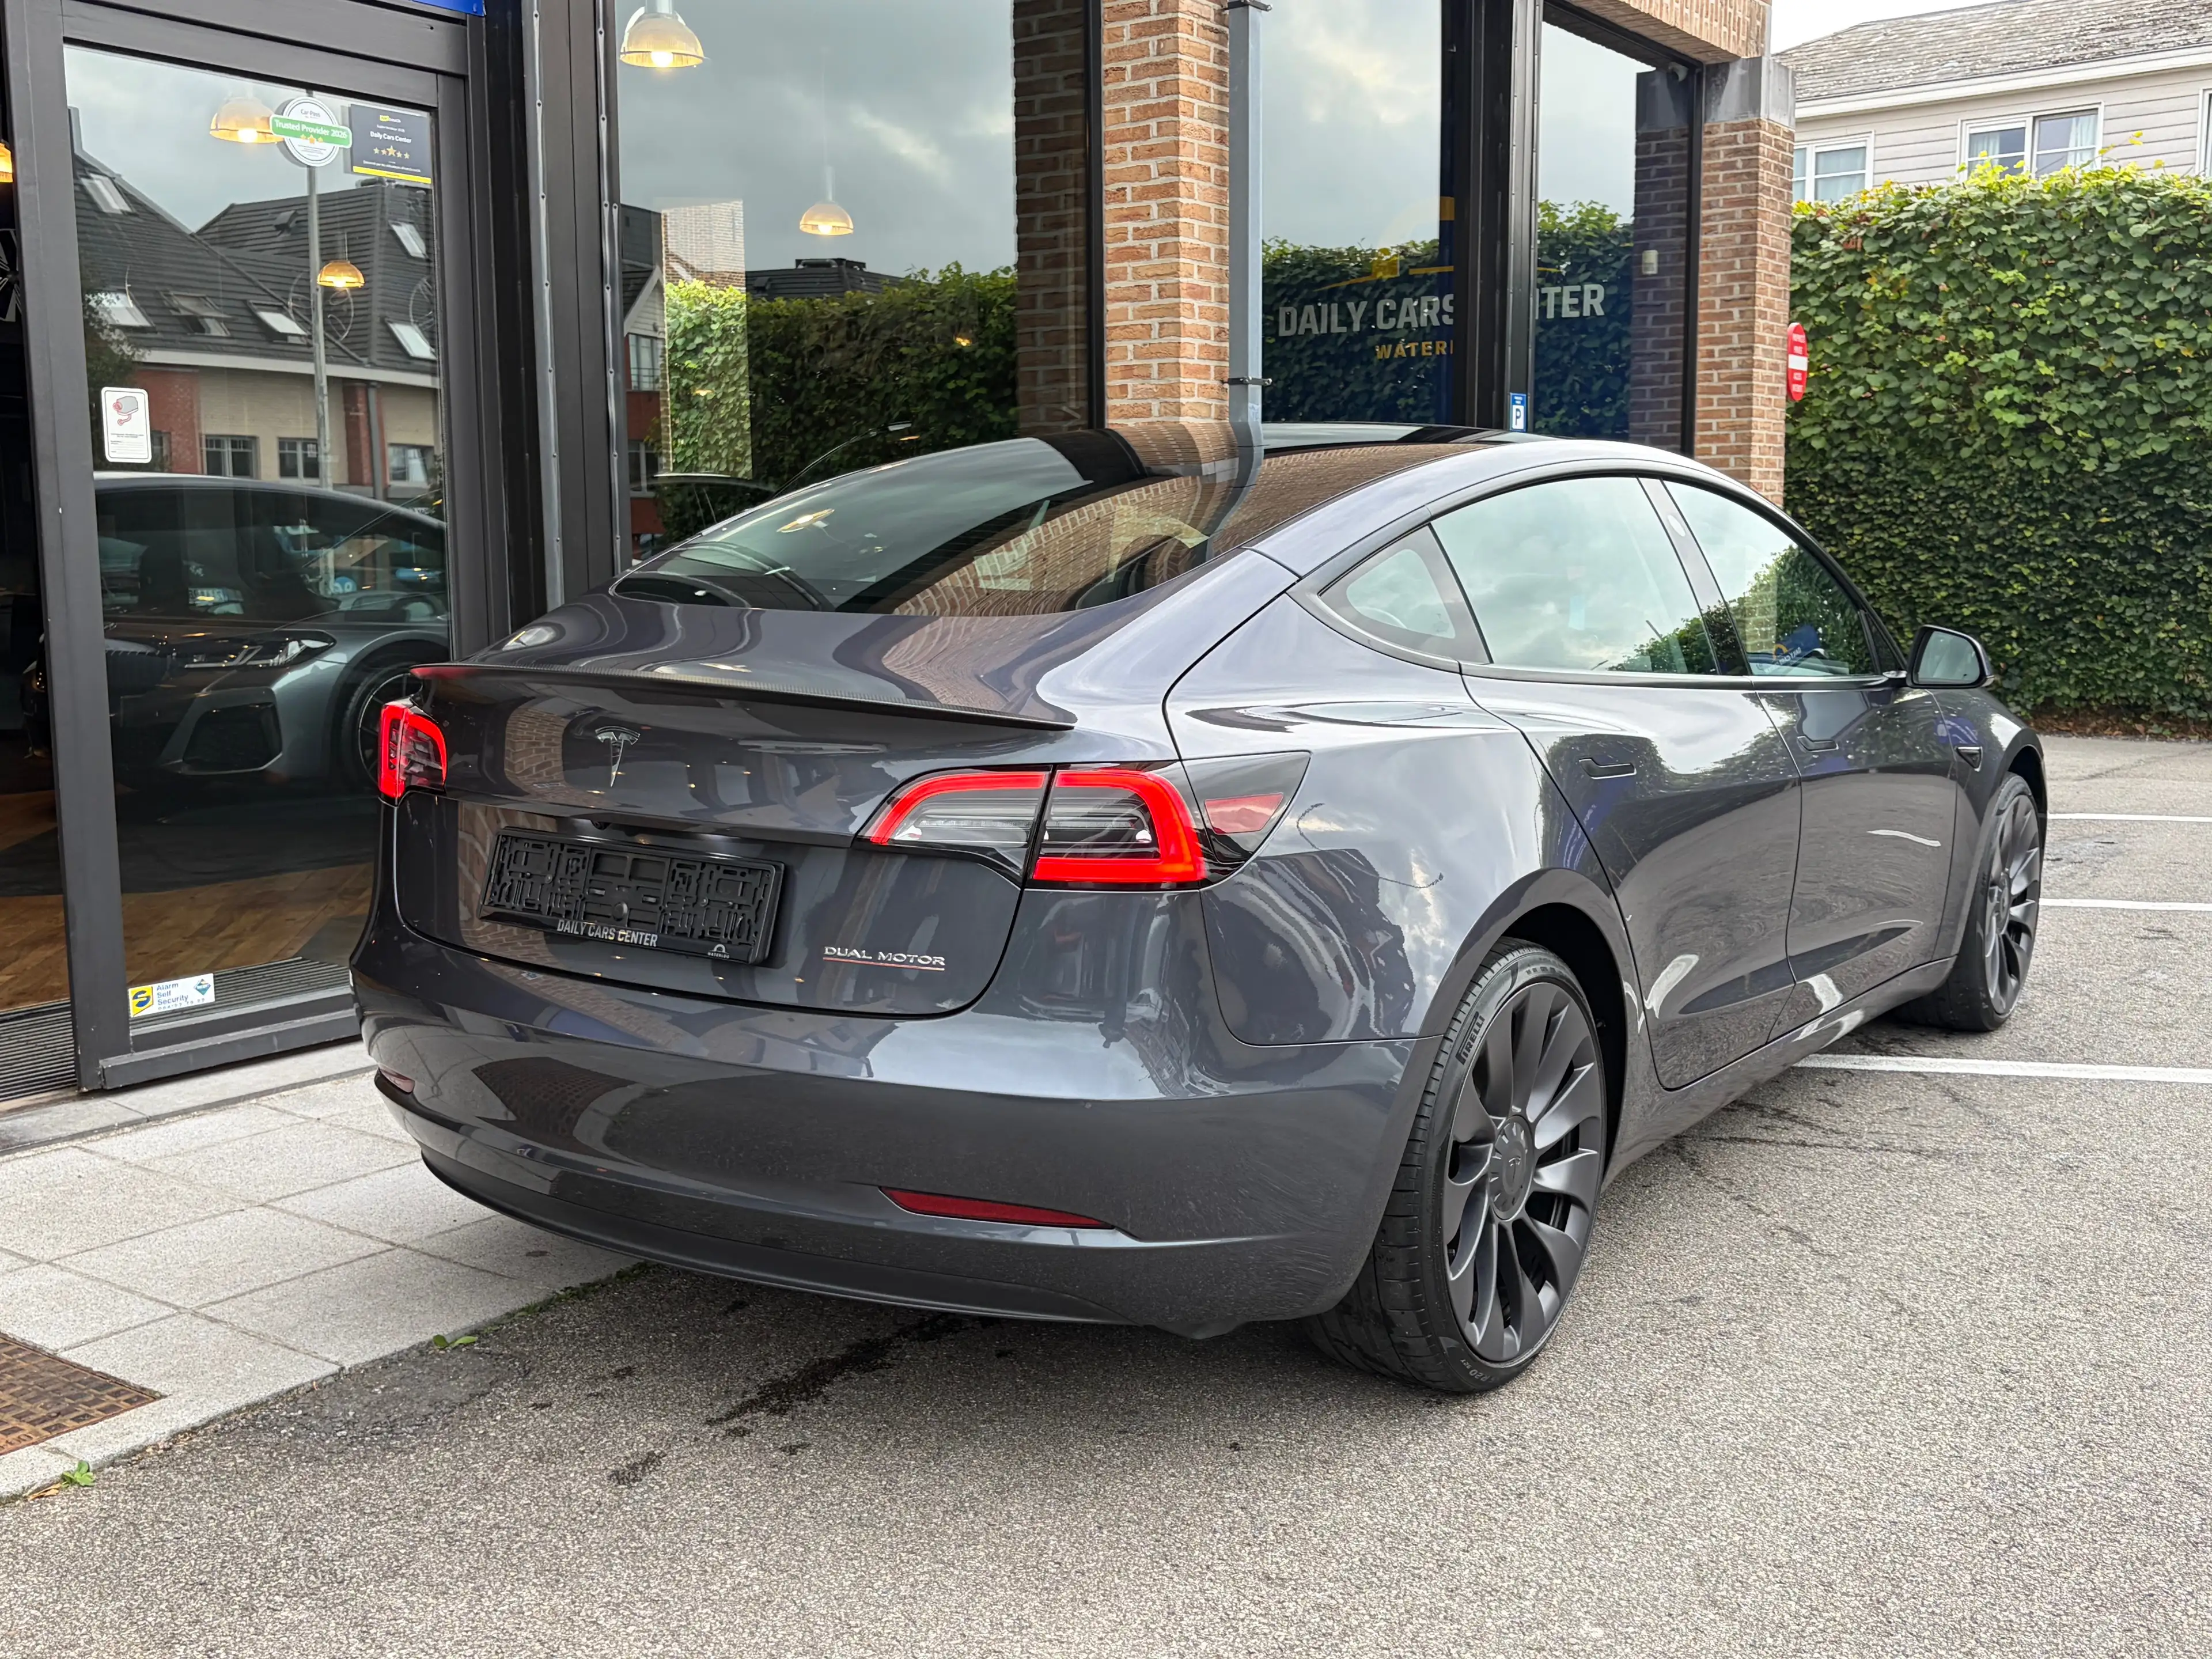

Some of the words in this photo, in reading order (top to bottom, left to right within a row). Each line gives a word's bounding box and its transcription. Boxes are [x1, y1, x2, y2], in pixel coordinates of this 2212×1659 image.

[274, 119, 300, 131] Trusted
[301, 124, 330, 136] Provider
[370, 131, 382, 139] Daily
[395, 135, 412, 143] Center
[1278, 301, 1368, 337] DAILY
[1377, 294, 1454, 329] CARS
[1535, 284, 1605, 320] TER
[1376, 340, 1453, 359] WATER
[1515, 408, 1521, 426] P
[557, 919, 586, 935] DAILY
[588, 925, 616, 940] CARS
[618, 929, 658, 947] CENTER
[824, 946, 873, 960] DUAL
[877, 951, 945, 965] MOTOR
[157, 995, 188, 1006] Security
[1455, 1011, 1485, 1065] PIRELLI
